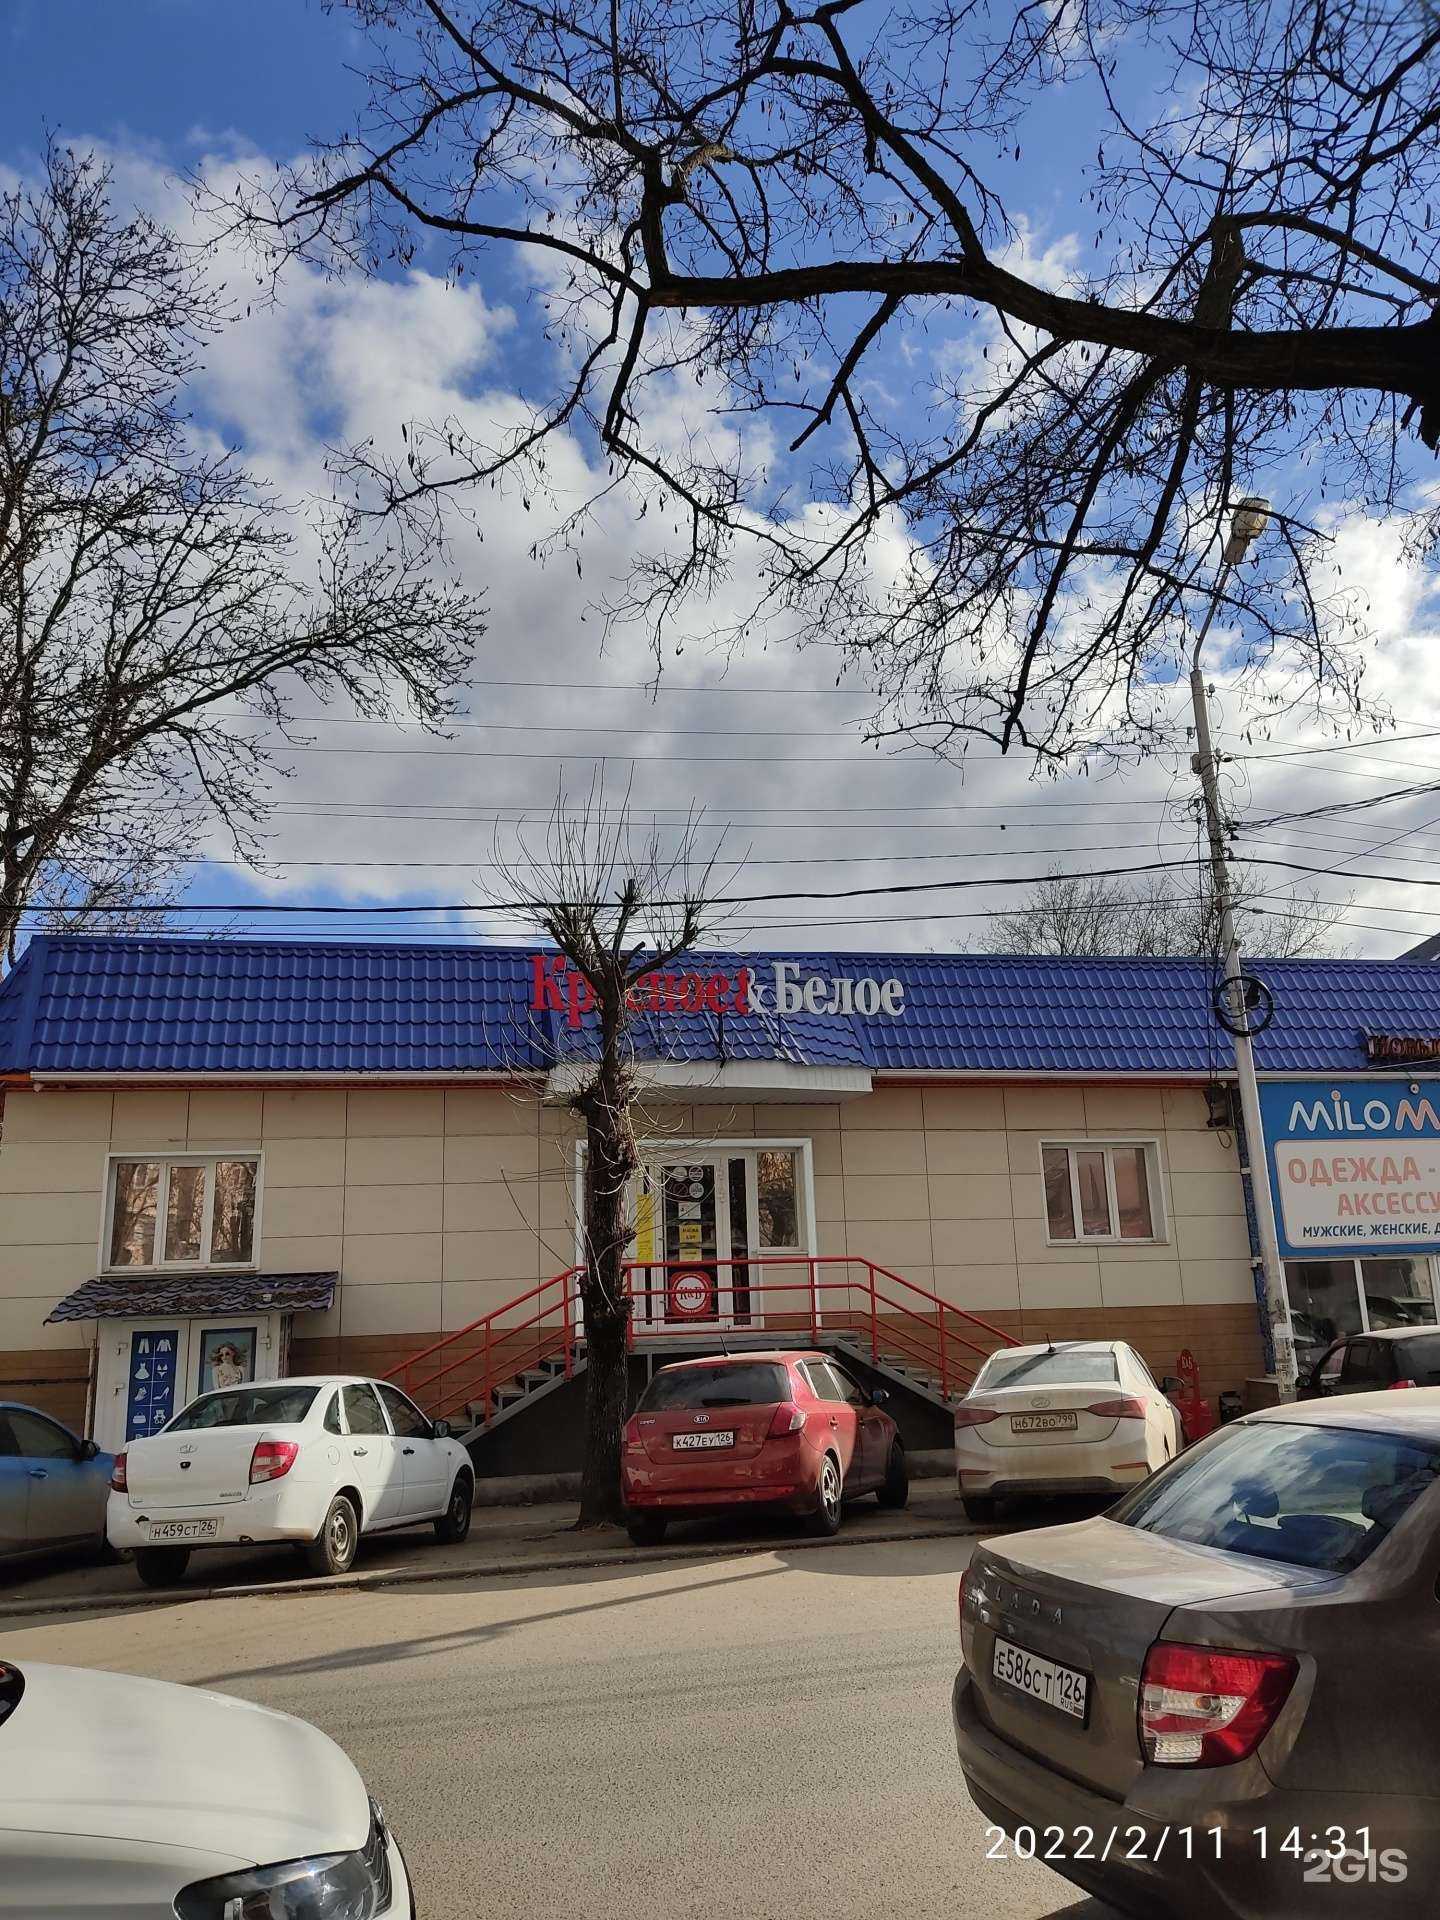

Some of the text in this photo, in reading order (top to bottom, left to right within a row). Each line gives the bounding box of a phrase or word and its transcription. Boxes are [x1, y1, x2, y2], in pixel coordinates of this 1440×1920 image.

[1288, 1156, 1421, 1186] ОДЕЖДА
[1303, 1224, 1367, 1238] МУЖСКИЕ,
[1370, 1222, 1431, 1236] ЖЕНСКИЕ,
